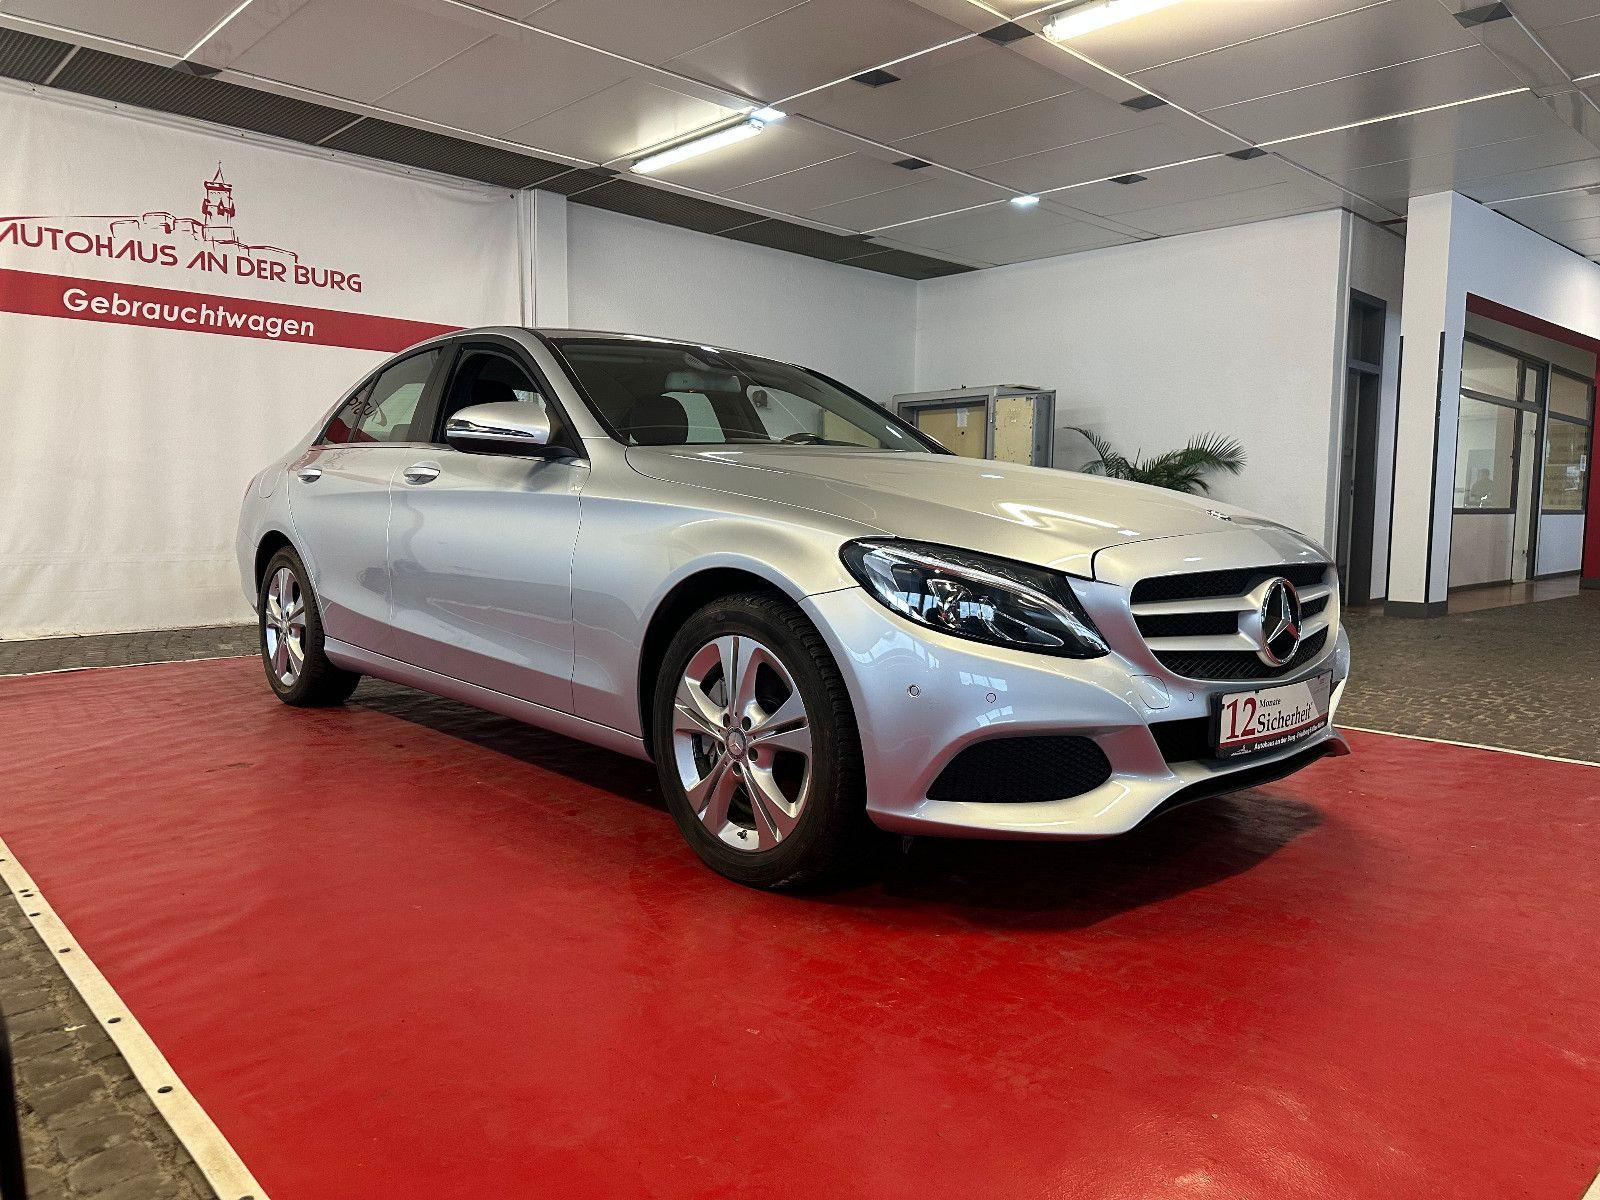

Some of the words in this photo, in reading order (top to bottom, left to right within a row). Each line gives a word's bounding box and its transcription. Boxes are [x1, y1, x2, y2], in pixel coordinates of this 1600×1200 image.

[0, 222, 178, 266] AUTOHAUS
[187, 251, 228, 274] AN
[236, 256, 287, 282] DER
[295, 264, 362, 293] BURG
[62, 288, 315, 338] Gebrauchtwagen
[1226, 697, 1256, 739] 12
[1257, 703, 1311, 733] Sicherheit
